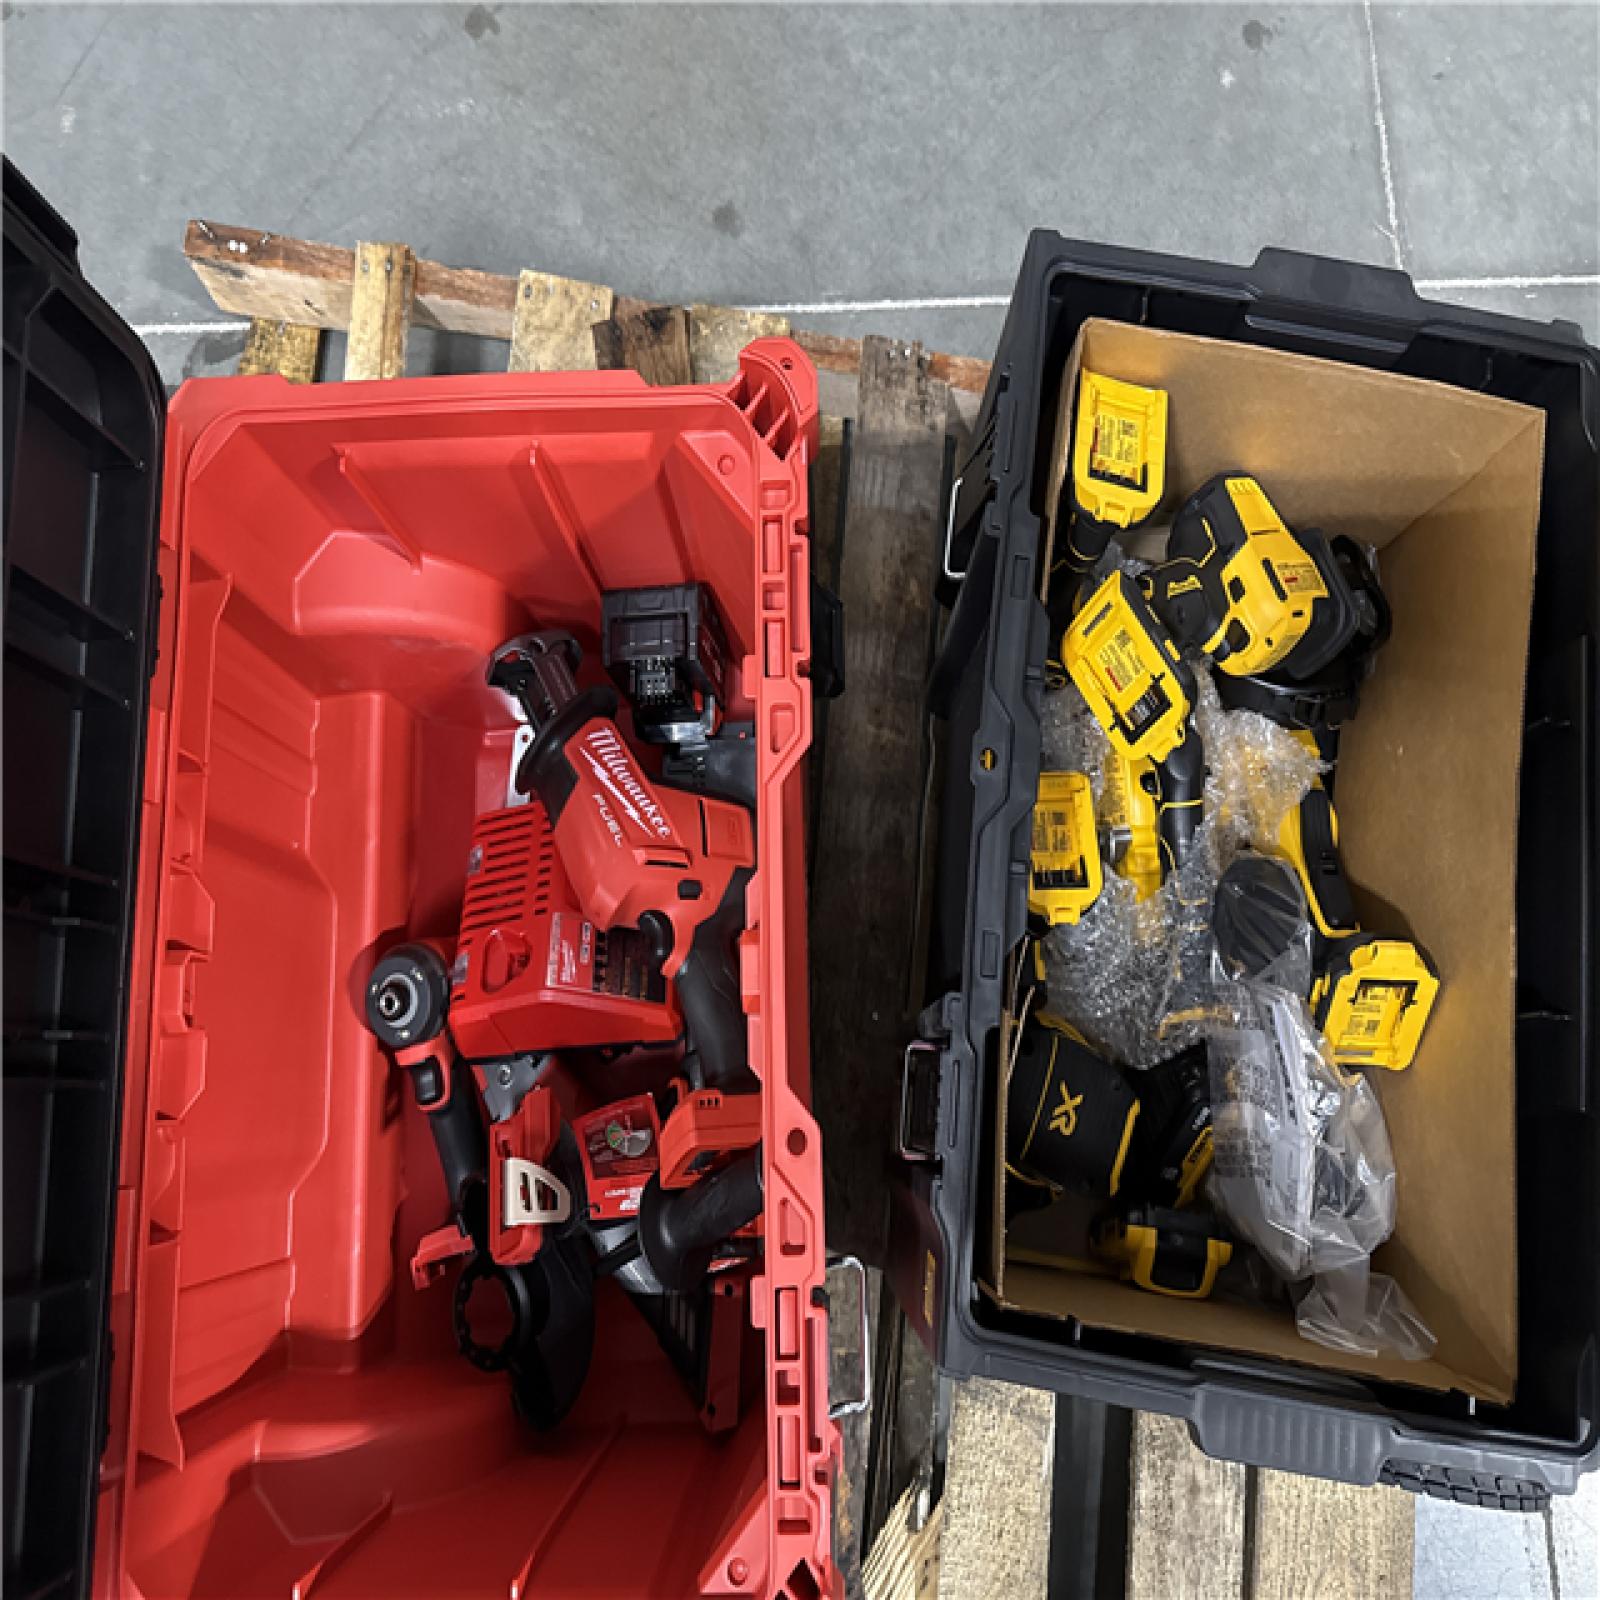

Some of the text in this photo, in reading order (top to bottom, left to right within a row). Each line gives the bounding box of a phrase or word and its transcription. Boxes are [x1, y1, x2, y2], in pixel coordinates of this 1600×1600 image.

[586, 727, 670, 839] Milwaukee
[592, 792, 623, 848] FUEL
[1049, 1079, 1084, 1136] XR
